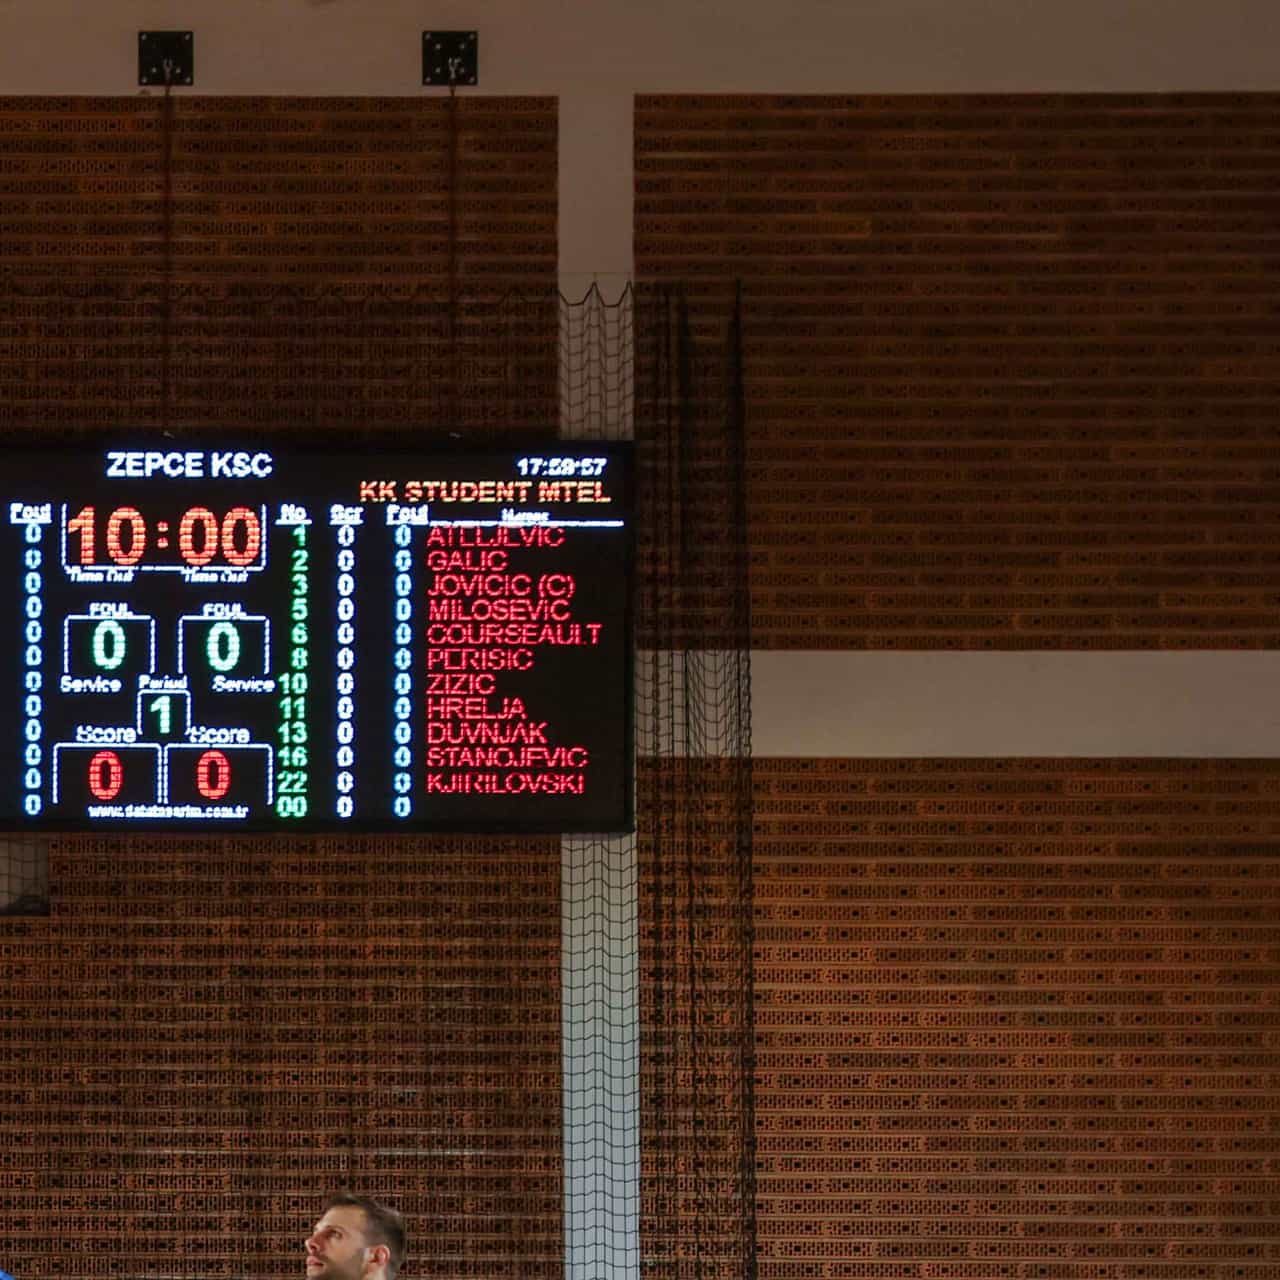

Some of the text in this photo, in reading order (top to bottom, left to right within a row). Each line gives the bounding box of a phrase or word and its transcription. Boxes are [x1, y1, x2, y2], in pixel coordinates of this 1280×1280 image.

[211, 452, 272, 478] KSC
[360, 481, 611, 502] KK STUDENT MTEL
[281, 504, 306, 521] No
[68, 506, 260, 565] 10:00
[293, 526, 305, 546] 1
[293, 549, 412, 572] 2 0
[428, 551, 508, 571] GALIC
[292, 574, 308, 595] 3
[428, 575, 575, 597] JOVICIC (C)
[292, 598, 307, 620] 5
[428, 600, 571, 620] MILOSEVIC
[93, 620, 125, 669] 0
[292, 622, 412, 645] 6 0
[207, 622, 240, 671] 0
[292, 648, 307, 669] 8
[279, 673, 307, 694] 10
[426, 674, 496, 694] ZIZIC
[150, 696, 170, 734] 1
[280, 696, 412, 720] 11 0
[426, 698, 527, 718] HRELJA
[278, 721, 307, 743] 13
[426, 722, 548, 742] DUVNJAK
[278, 746, 307, 766] 16
[89, 751, 122, 800] 0
[196, 750, 231, 800] 0
[277, 771, 411, 793] 22 0
[277, 796, 307, 817] 00
